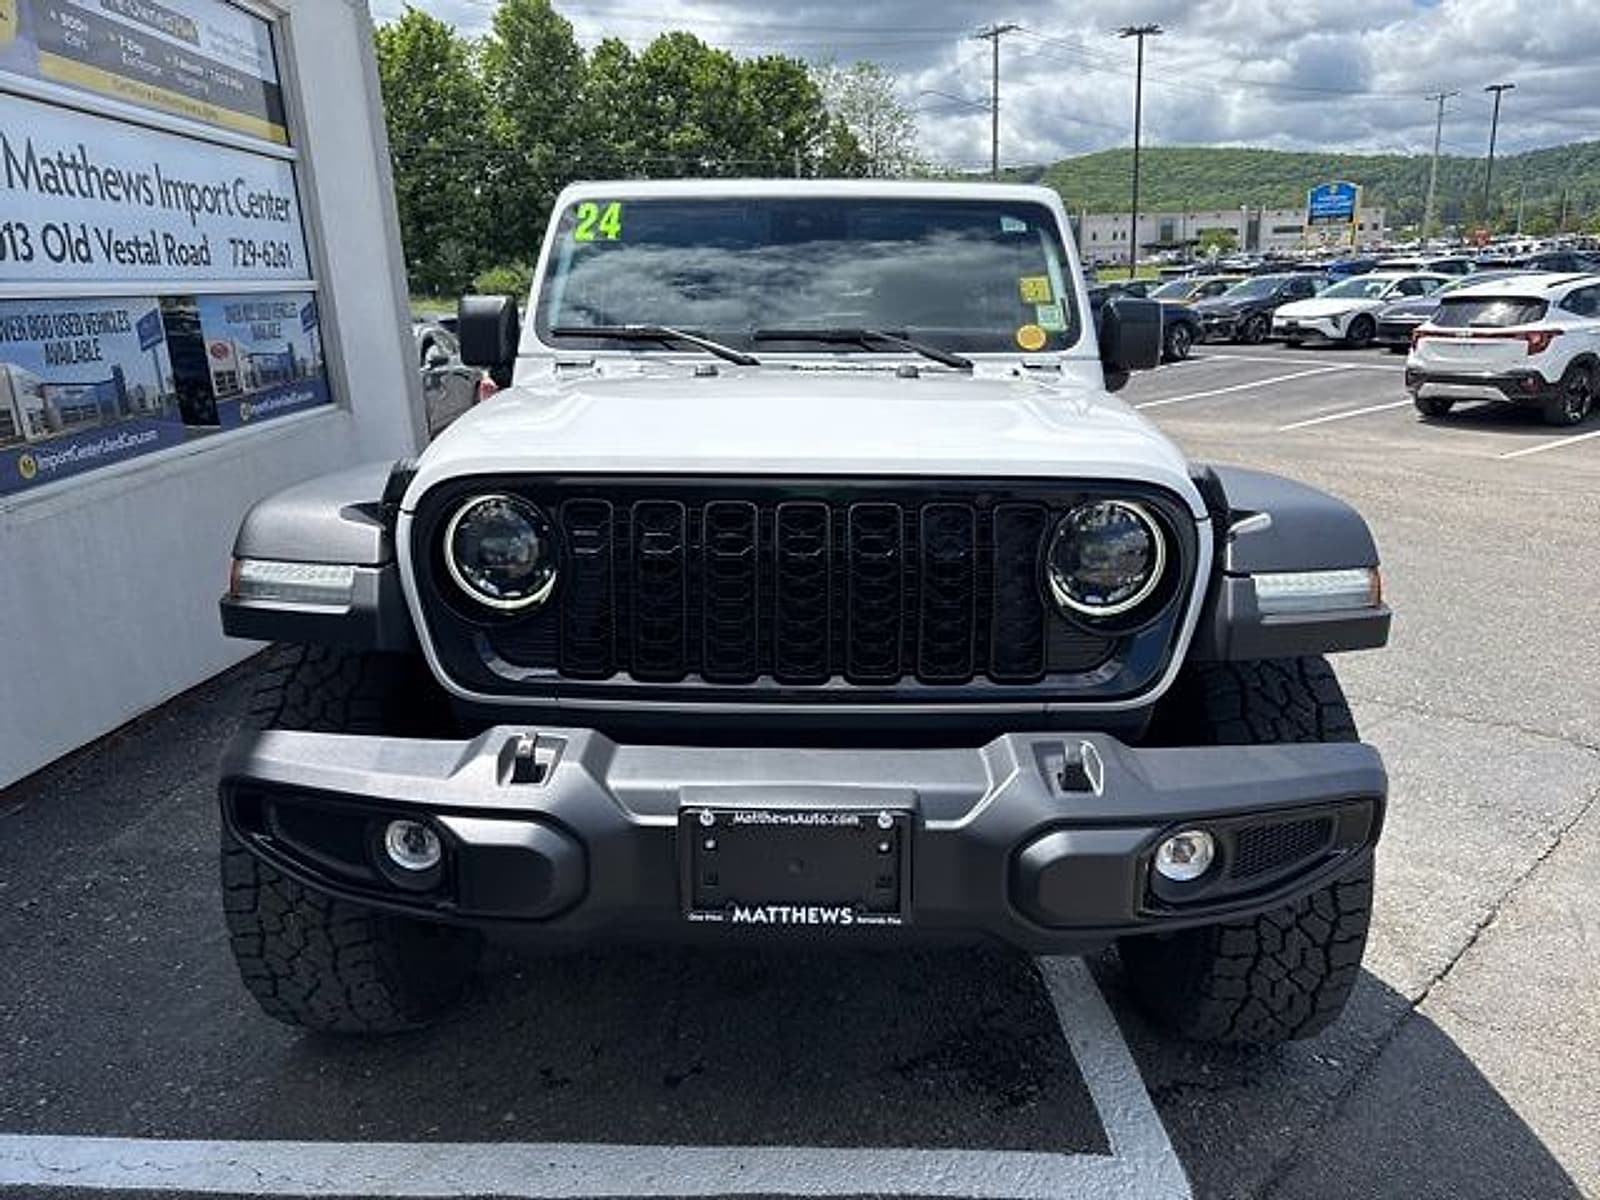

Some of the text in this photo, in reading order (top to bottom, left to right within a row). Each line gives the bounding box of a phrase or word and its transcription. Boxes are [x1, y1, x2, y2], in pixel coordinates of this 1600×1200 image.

[0, 131, 291, 227] Matthews Import Center
[575, 202, 622, 241] 24
[42, 222, 94, 263] Old
[94, 227, 161, 266] Vestal
[163, 233, 211, 266] Road
[229, 237, 294, 269] 729-6261
[0, 315, 28, 341] VER
[734, 810, 860, 826] MatthewsAuto.com
[732, 904, 853, 924] MATTHEWS
